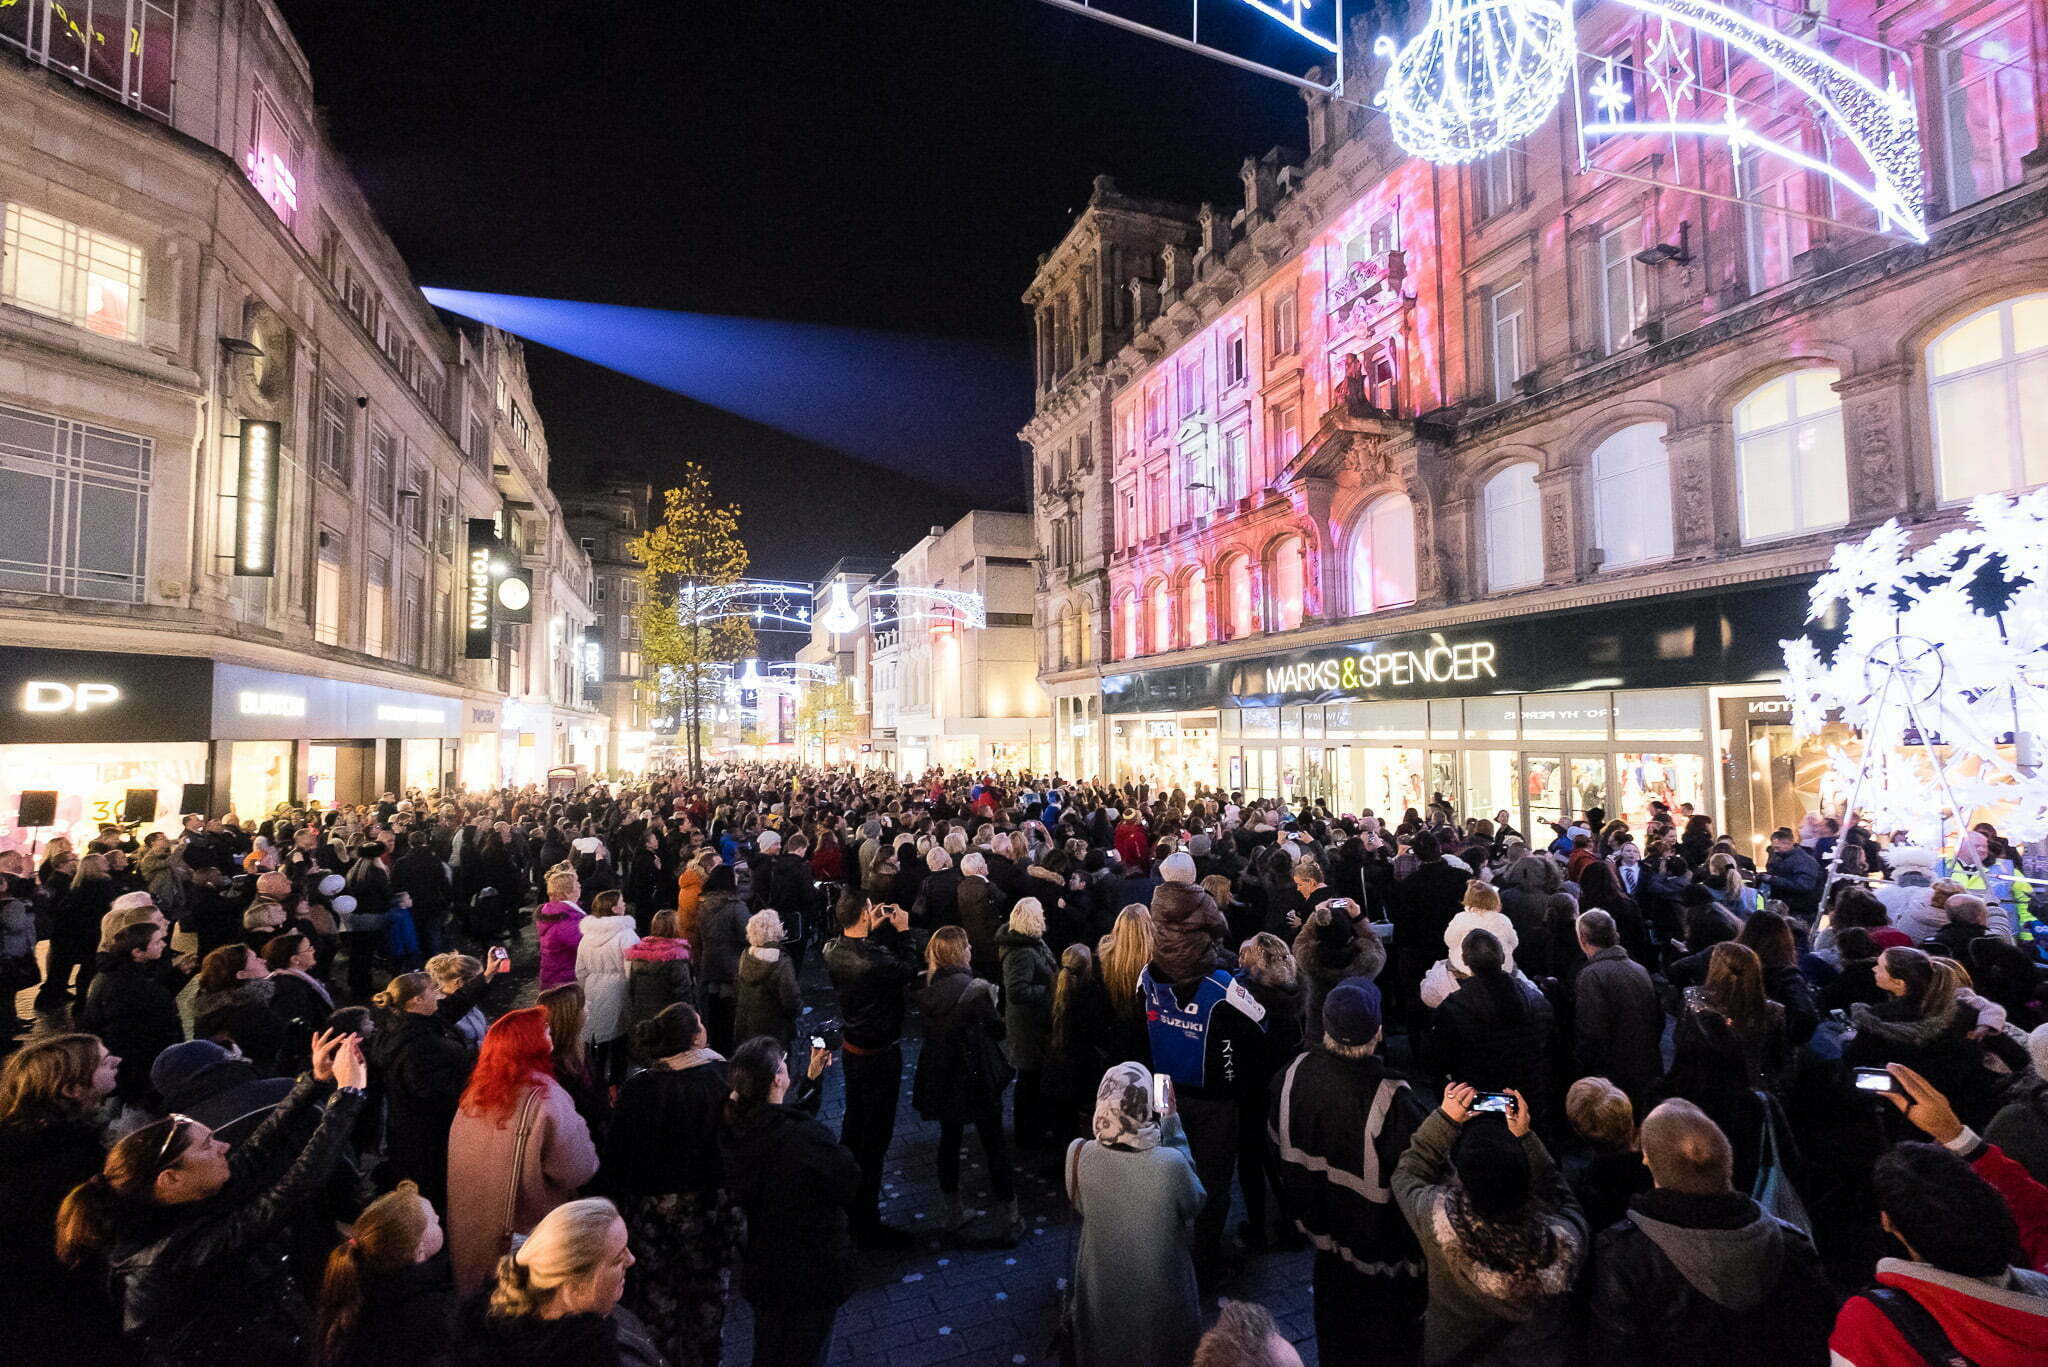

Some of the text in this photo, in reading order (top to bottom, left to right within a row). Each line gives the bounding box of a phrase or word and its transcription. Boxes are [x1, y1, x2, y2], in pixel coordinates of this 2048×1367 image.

[471, 549, 488, 630] TOPMAN
[585, 643, 600, 682] next
[24, 681, 120, 712] DP
[1160, 1014, 1203, 1032] SUZUKI
